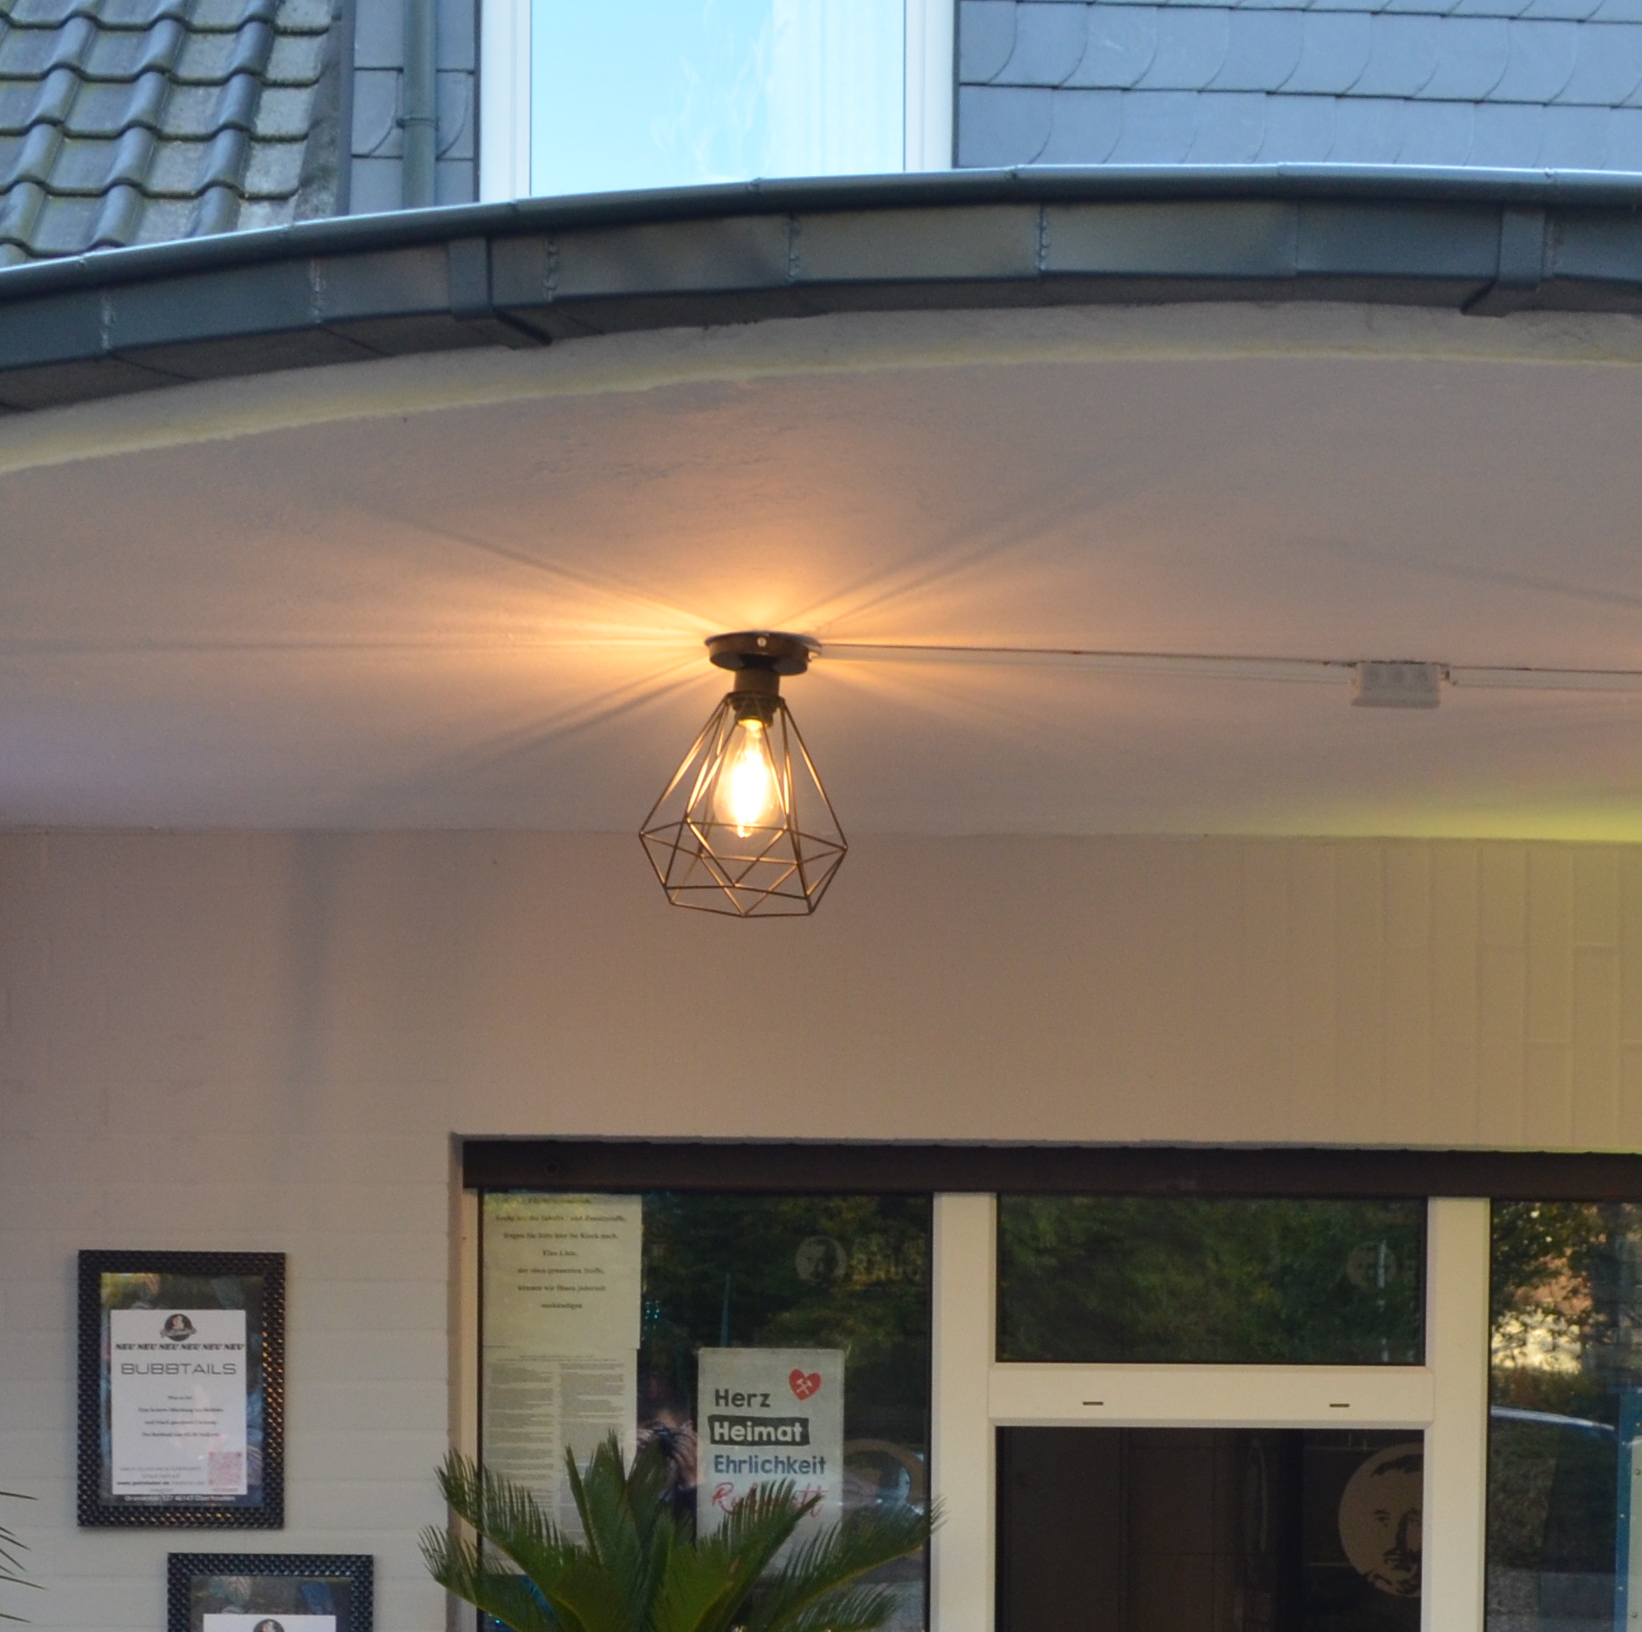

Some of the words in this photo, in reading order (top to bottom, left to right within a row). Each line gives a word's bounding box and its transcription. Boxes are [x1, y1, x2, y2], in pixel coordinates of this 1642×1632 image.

[121, 1363, 237, 1375] BUBBTAILS
[714, 1388, 771, 1408] Herz
[713, 1421, 803, 1442] Heimat
[714, 1454, 826, 1475] Ehrlichkeit
